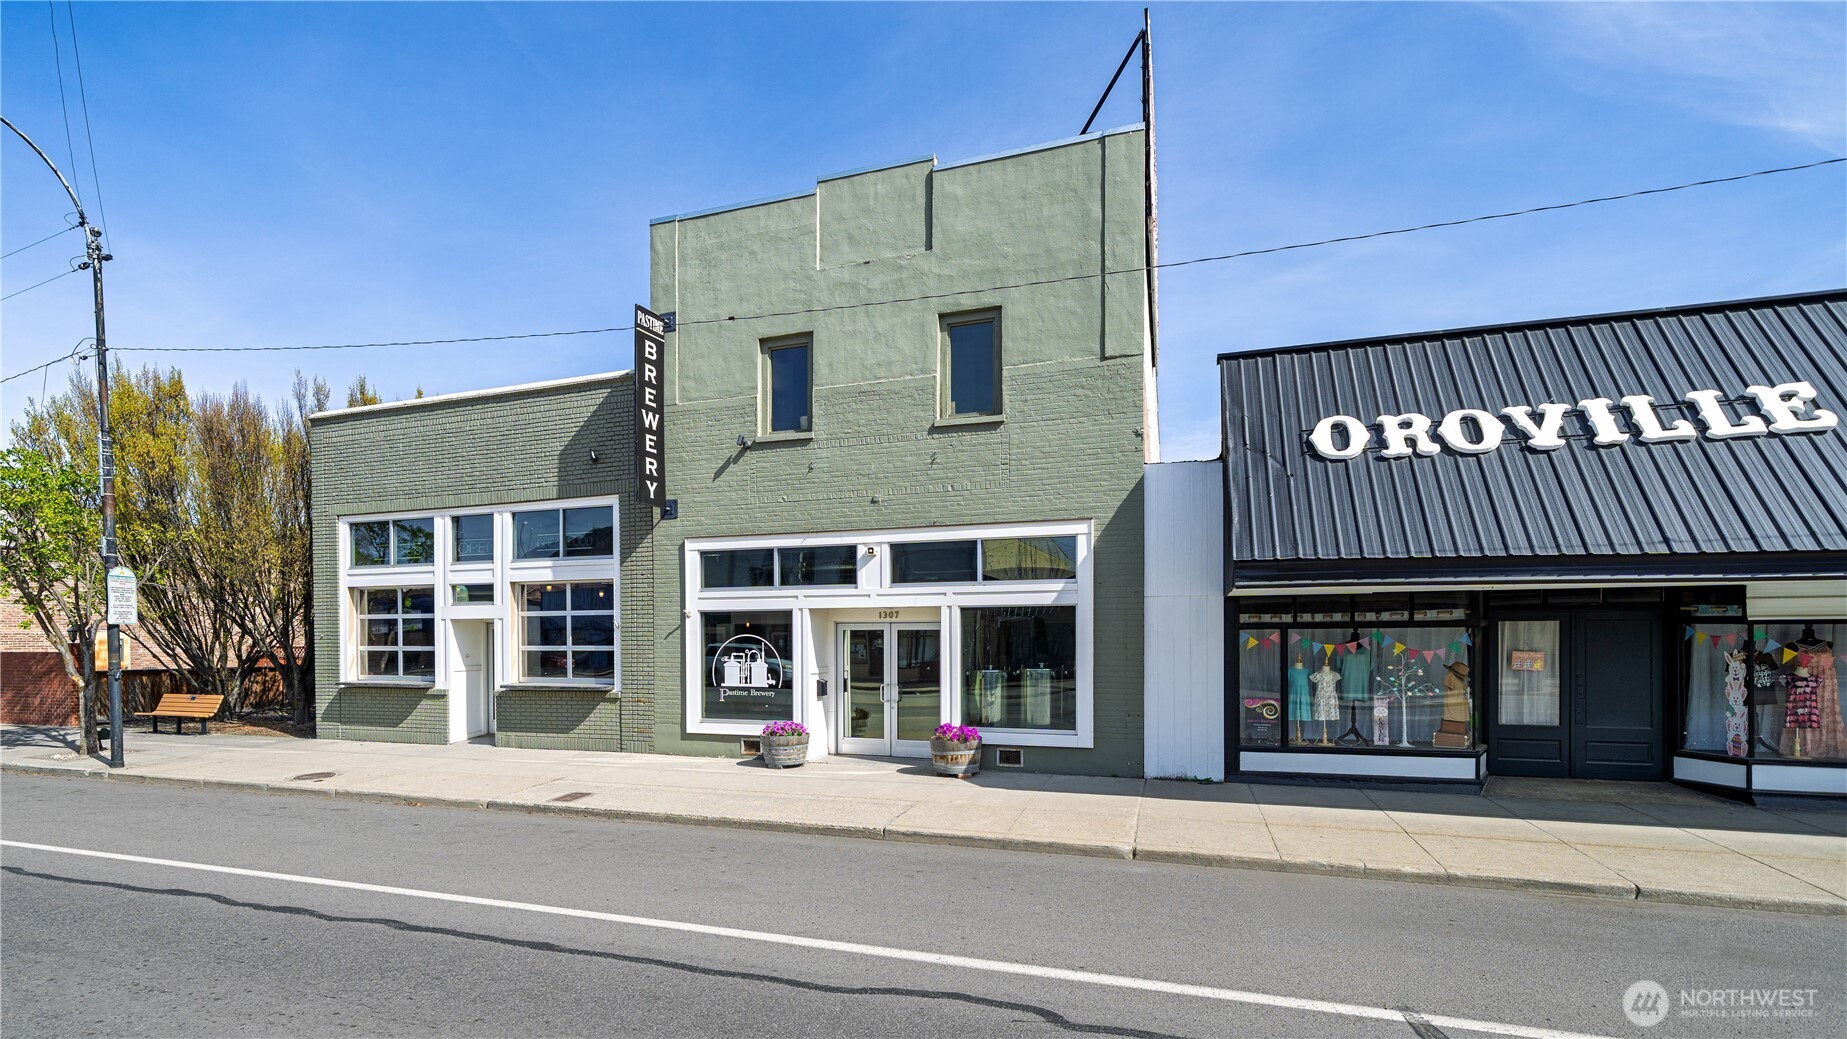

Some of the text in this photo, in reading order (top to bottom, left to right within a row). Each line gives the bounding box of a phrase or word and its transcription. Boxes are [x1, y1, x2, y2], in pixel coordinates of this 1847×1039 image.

[637, 310, 665, 336] PASTIME
[641, 340, 660, 499] BREWERY
[1308, 381, 1838, 460] OROVILLE
[878, 610, 900, 619] 1307
[719, 688, 776, 702] Pastime Brewery
